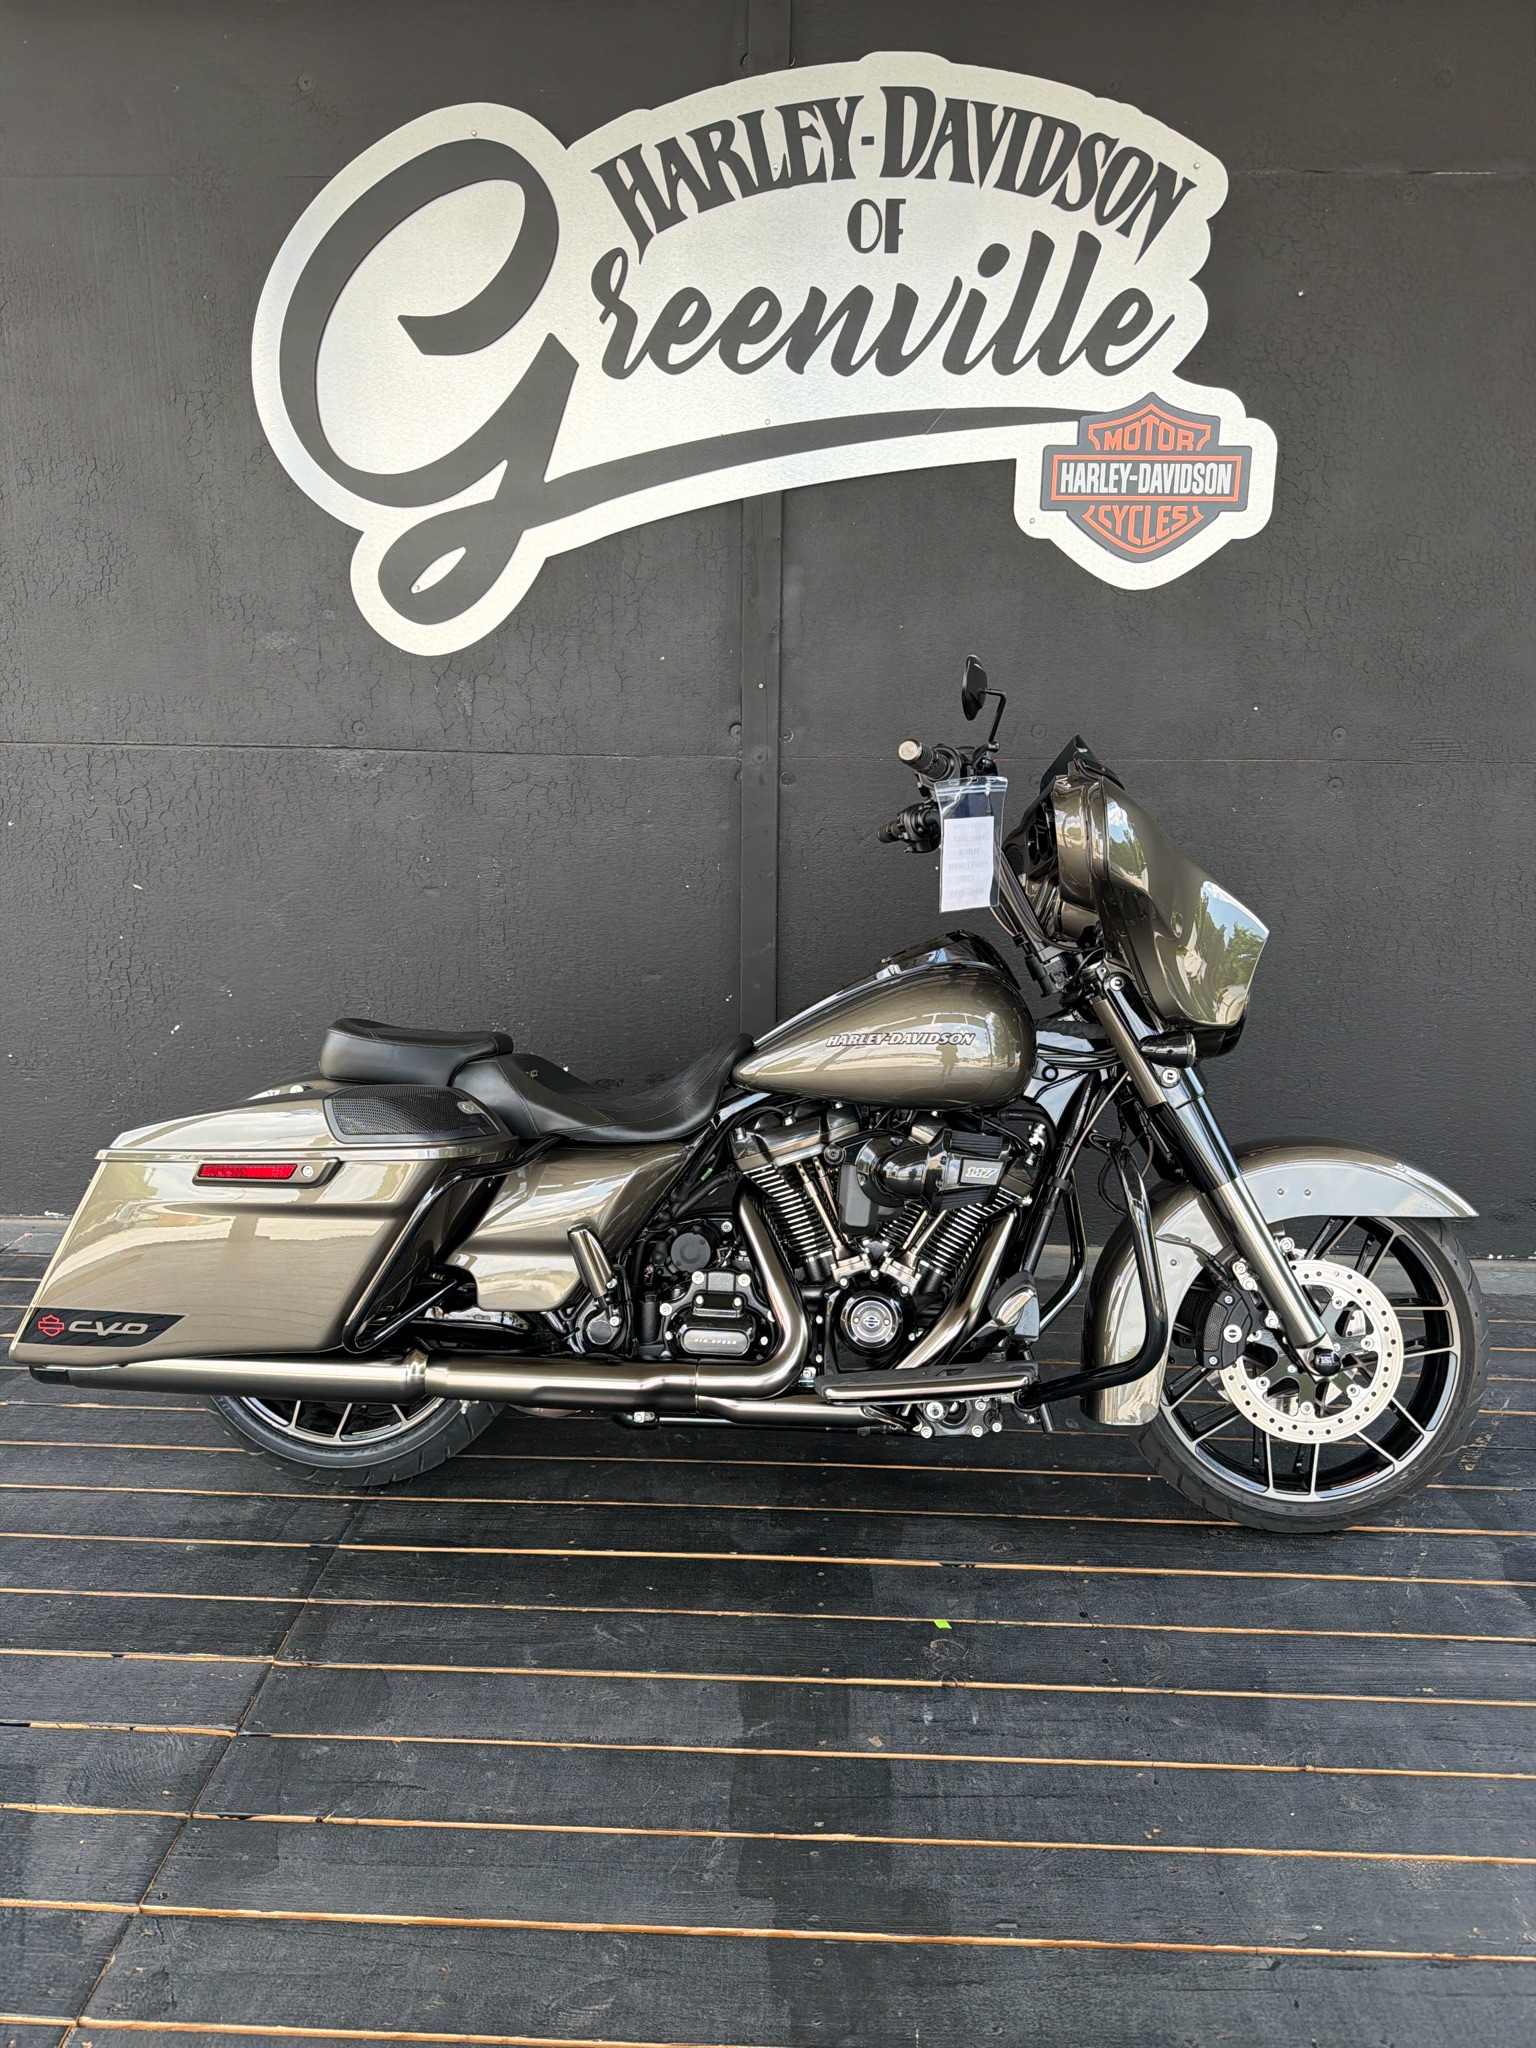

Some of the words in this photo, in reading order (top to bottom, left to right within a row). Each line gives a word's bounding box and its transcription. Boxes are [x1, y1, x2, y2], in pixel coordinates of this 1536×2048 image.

[590, 85, 1198, 266] HARLEY-DAVIDSON
[847, 198, 907, 255] OF
[279, 138, 1176, 625] Greenville
[1103, 414, 1195, 452] MOTOR
[1059, 461, 1233, 496] HARLEY-DAVIDSON
[1097, 504, 1189, 546] CYCLES
[826, 1032, 977, 1048] HARLEY-DAVIDSON
[965, 1166, 998, 1179] 117
[68, 1320, 149, 1337] CVO
